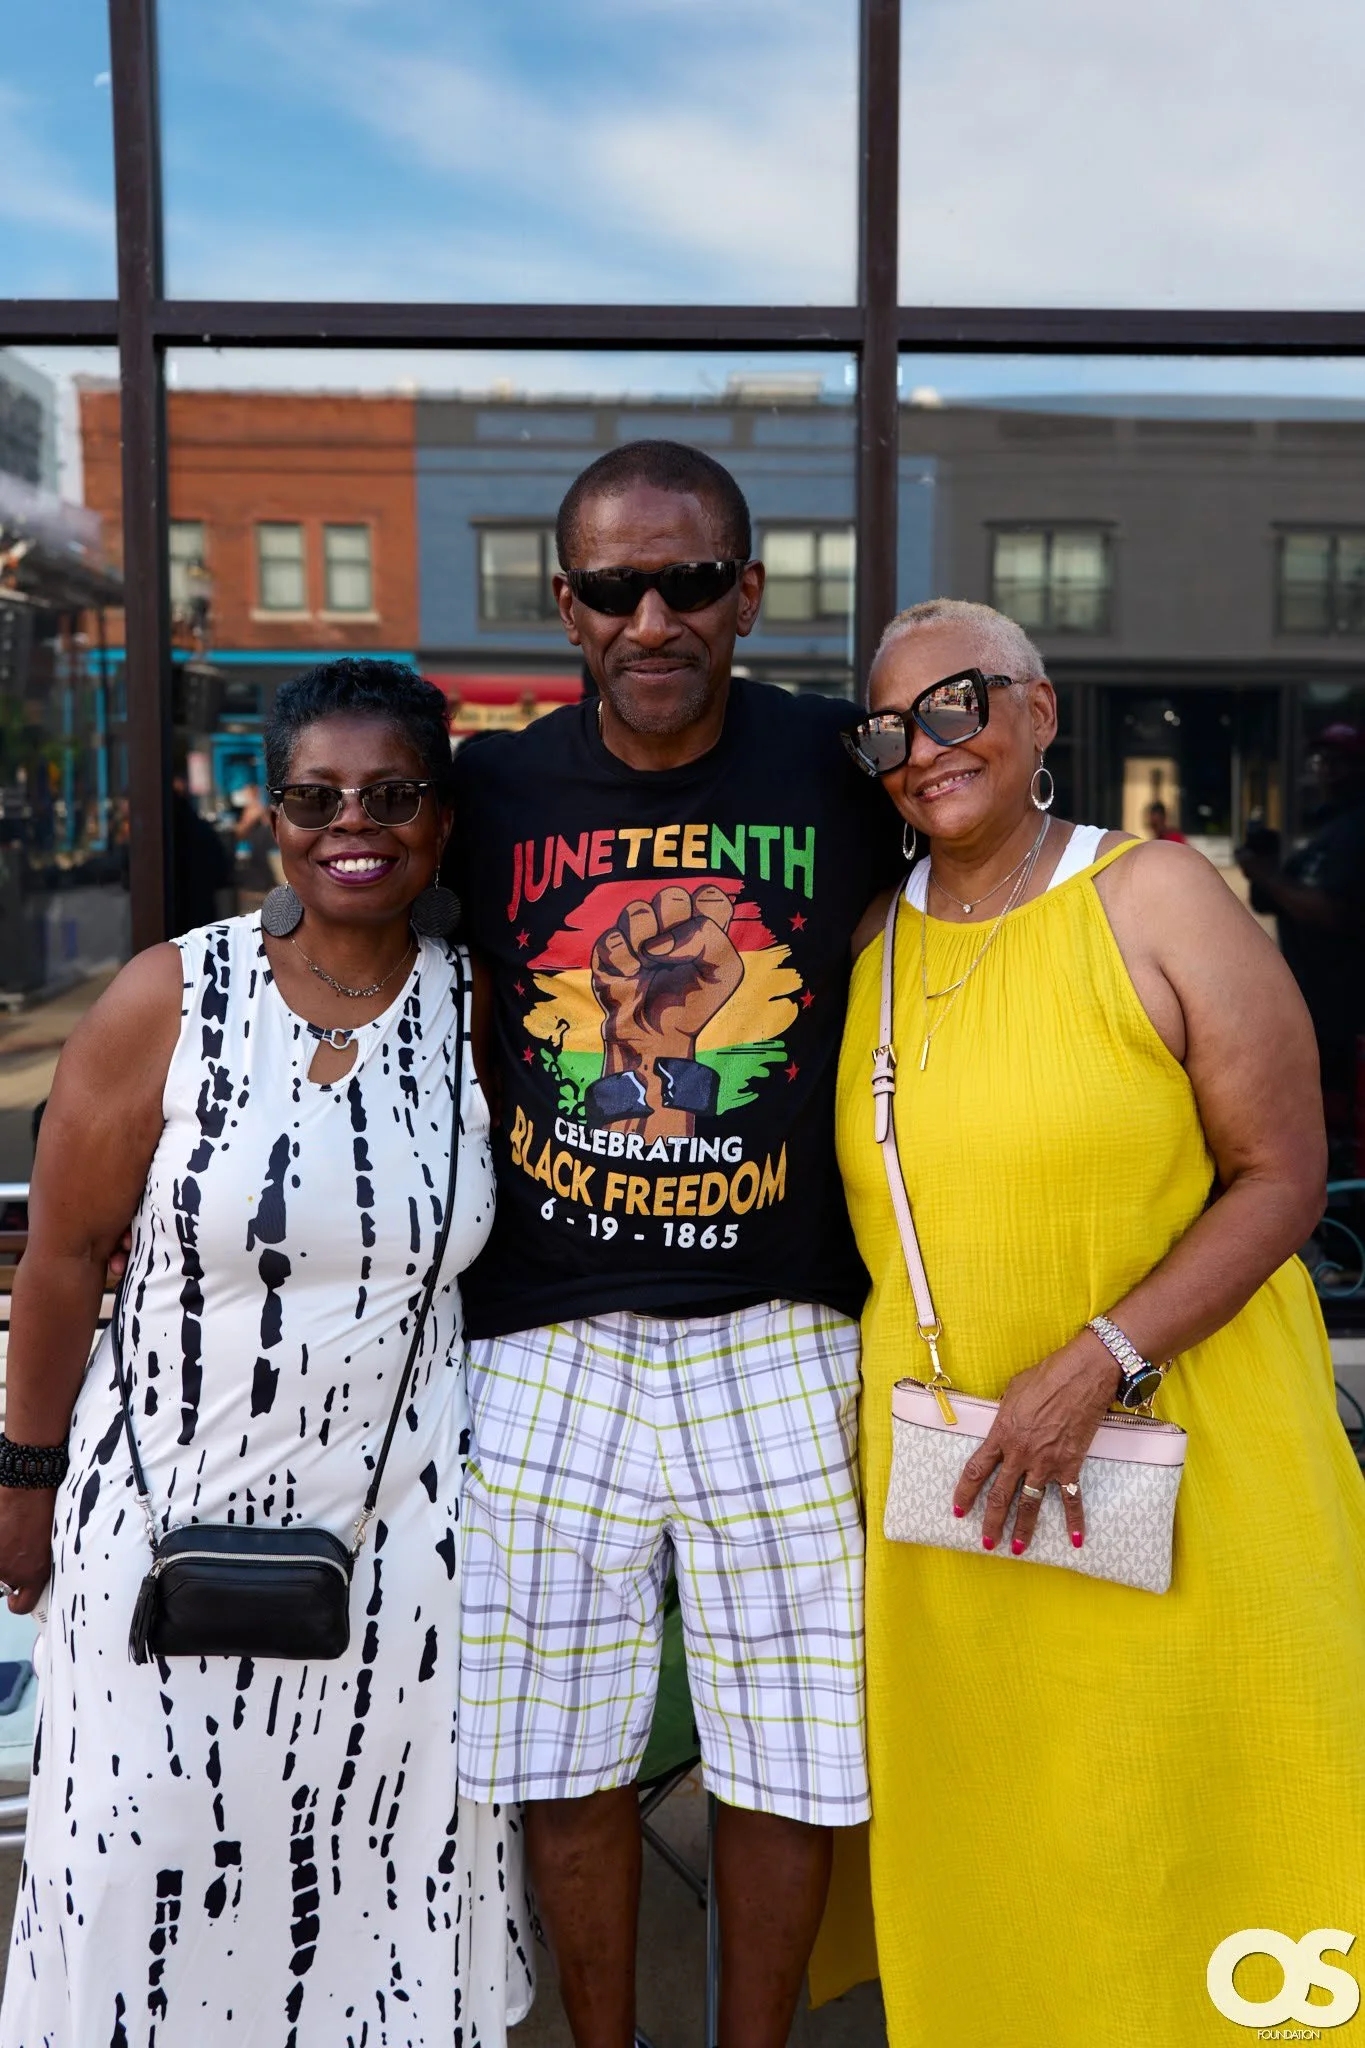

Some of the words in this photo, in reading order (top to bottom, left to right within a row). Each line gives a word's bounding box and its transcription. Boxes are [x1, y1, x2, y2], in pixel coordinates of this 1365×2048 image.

[508, 824, 815, 922] JUNETEENTH
[509, 1105, 598, 1207] BLACK
[603, 1141, 786, 1216] FREEDOM
[554, 1117, 743, 1164] CELEBRATING
[540, 1197, 556, 1221] 6
[588, 1213, 619, 1241] 19
[662, 1222, 740, 1250] 1865
